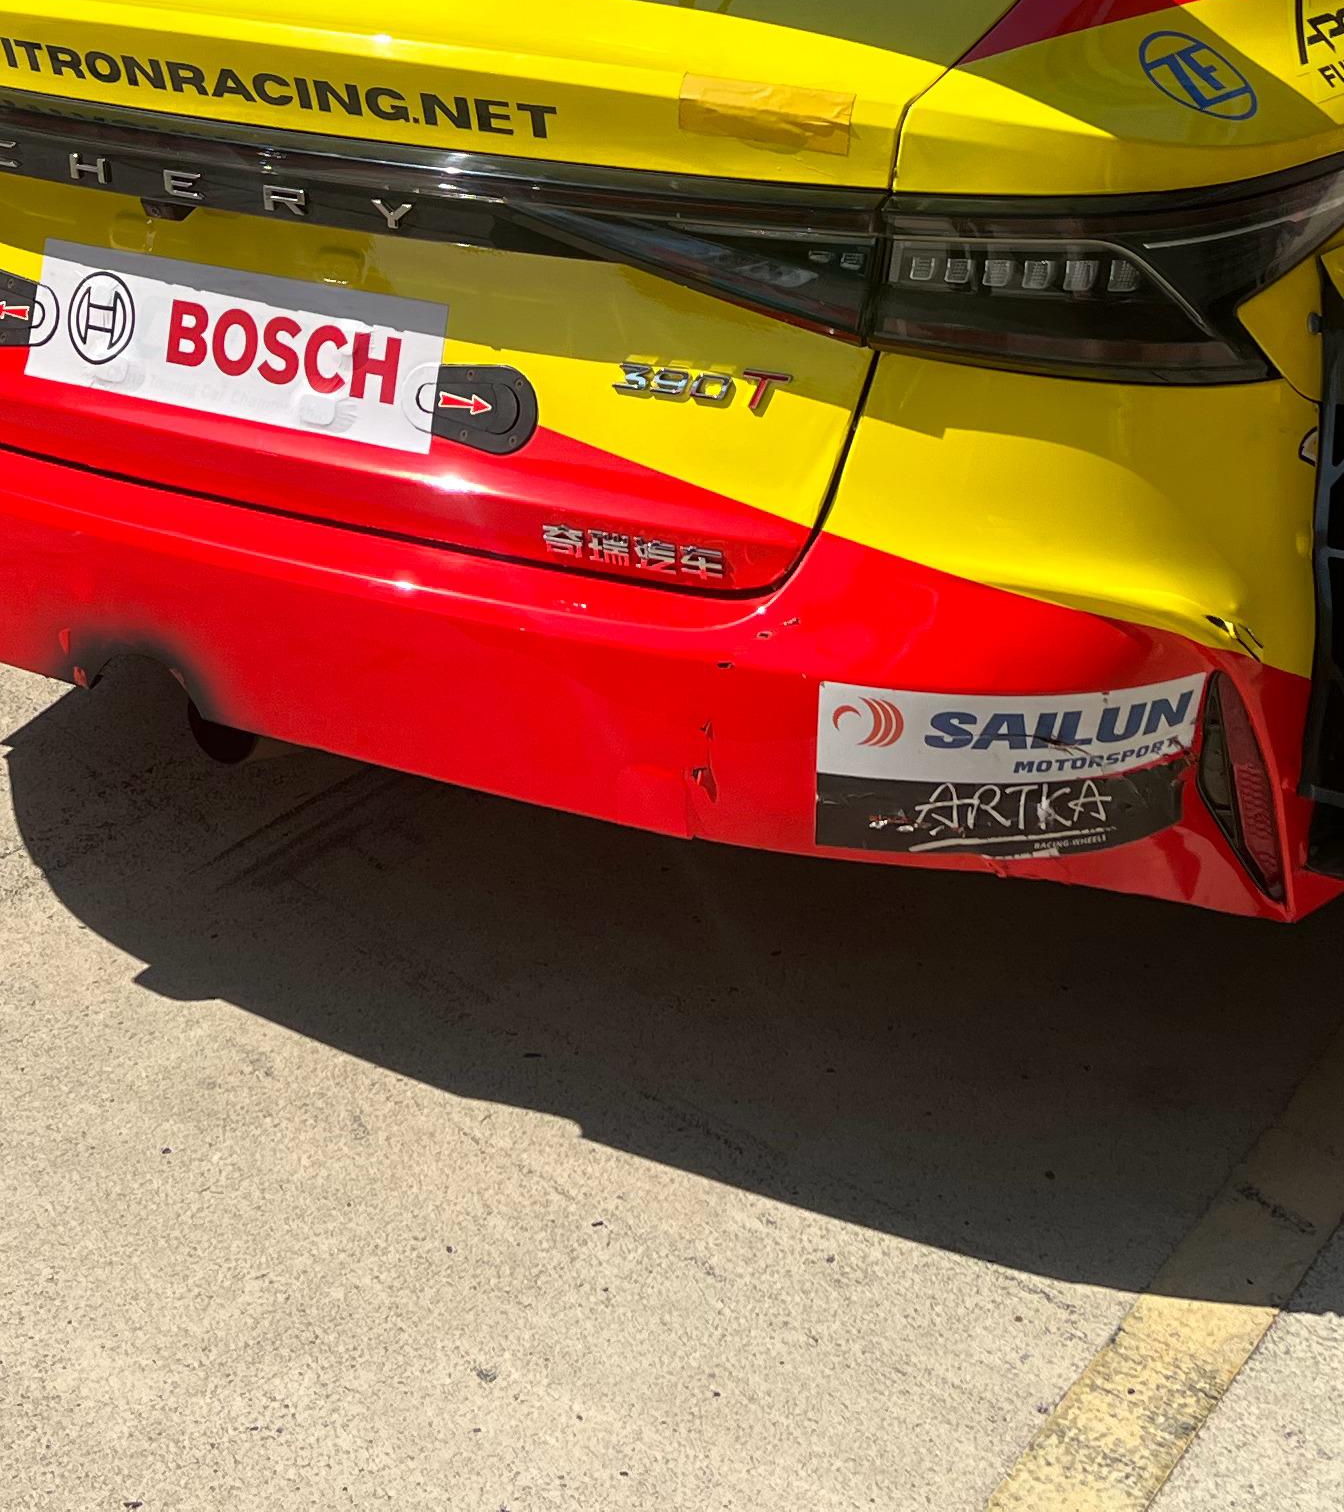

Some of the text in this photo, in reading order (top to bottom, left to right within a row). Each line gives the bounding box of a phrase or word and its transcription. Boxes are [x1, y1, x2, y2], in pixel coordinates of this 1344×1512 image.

[166, 298, 402, 405] BOSCH
[542, 524, 724, 580] 奇瑞汽车
[924, 689, 1195, 751] SAILUN
[1013, 735, 1180, 775] MOTORSPORT
[914, 779, 1113, 831] ARTKA
